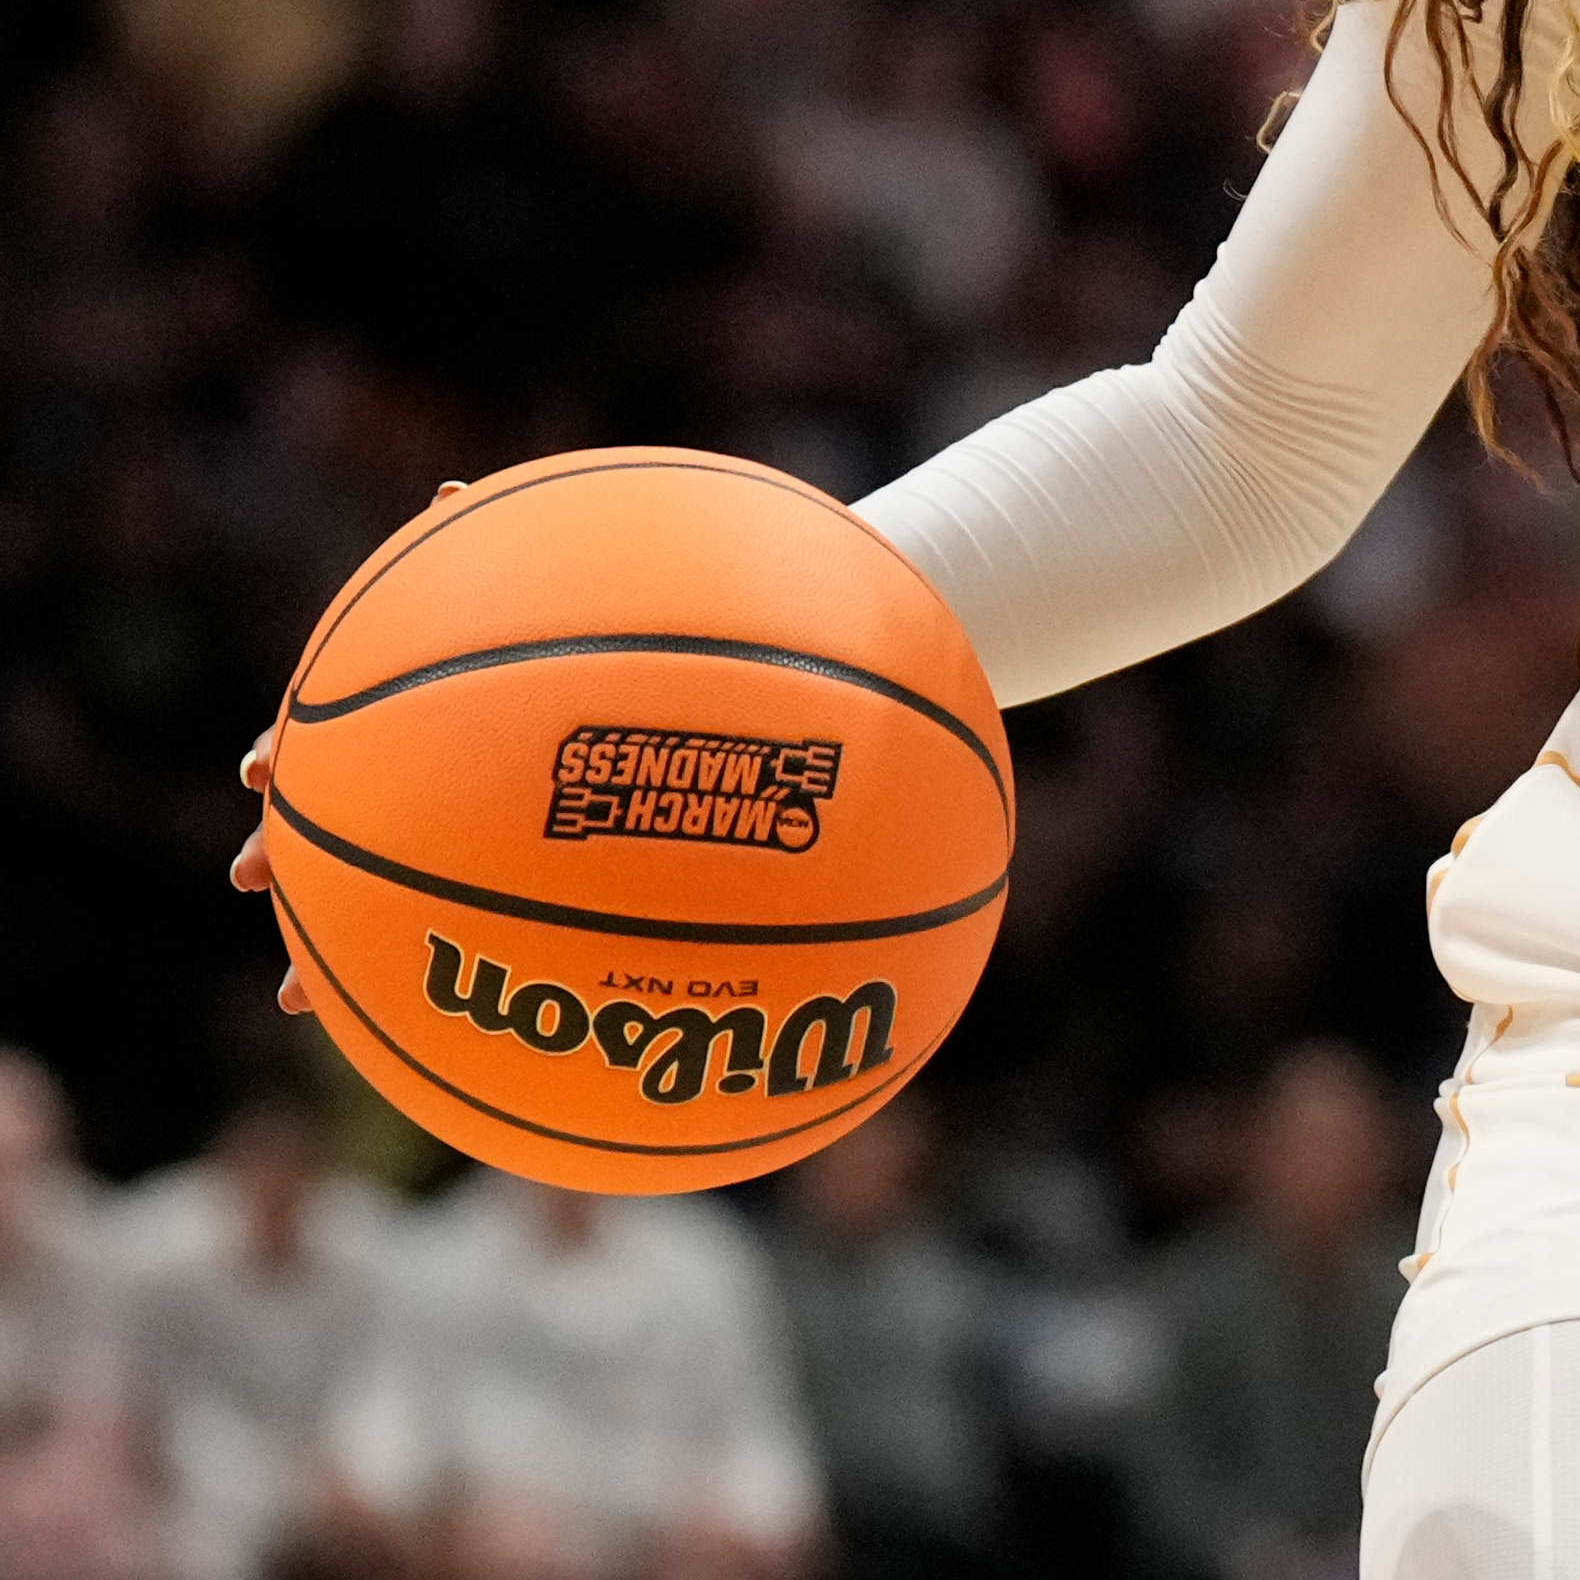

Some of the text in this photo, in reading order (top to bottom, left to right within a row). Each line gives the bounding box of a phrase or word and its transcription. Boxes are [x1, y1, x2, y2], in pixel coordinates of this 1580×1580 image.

[557, 742, 763, 795] MADNESS
[624, 790, 777, 842] MARCH
[599, 970, 759, 998] EVO NXT
[423, 928, 898, 1105] Wilson
